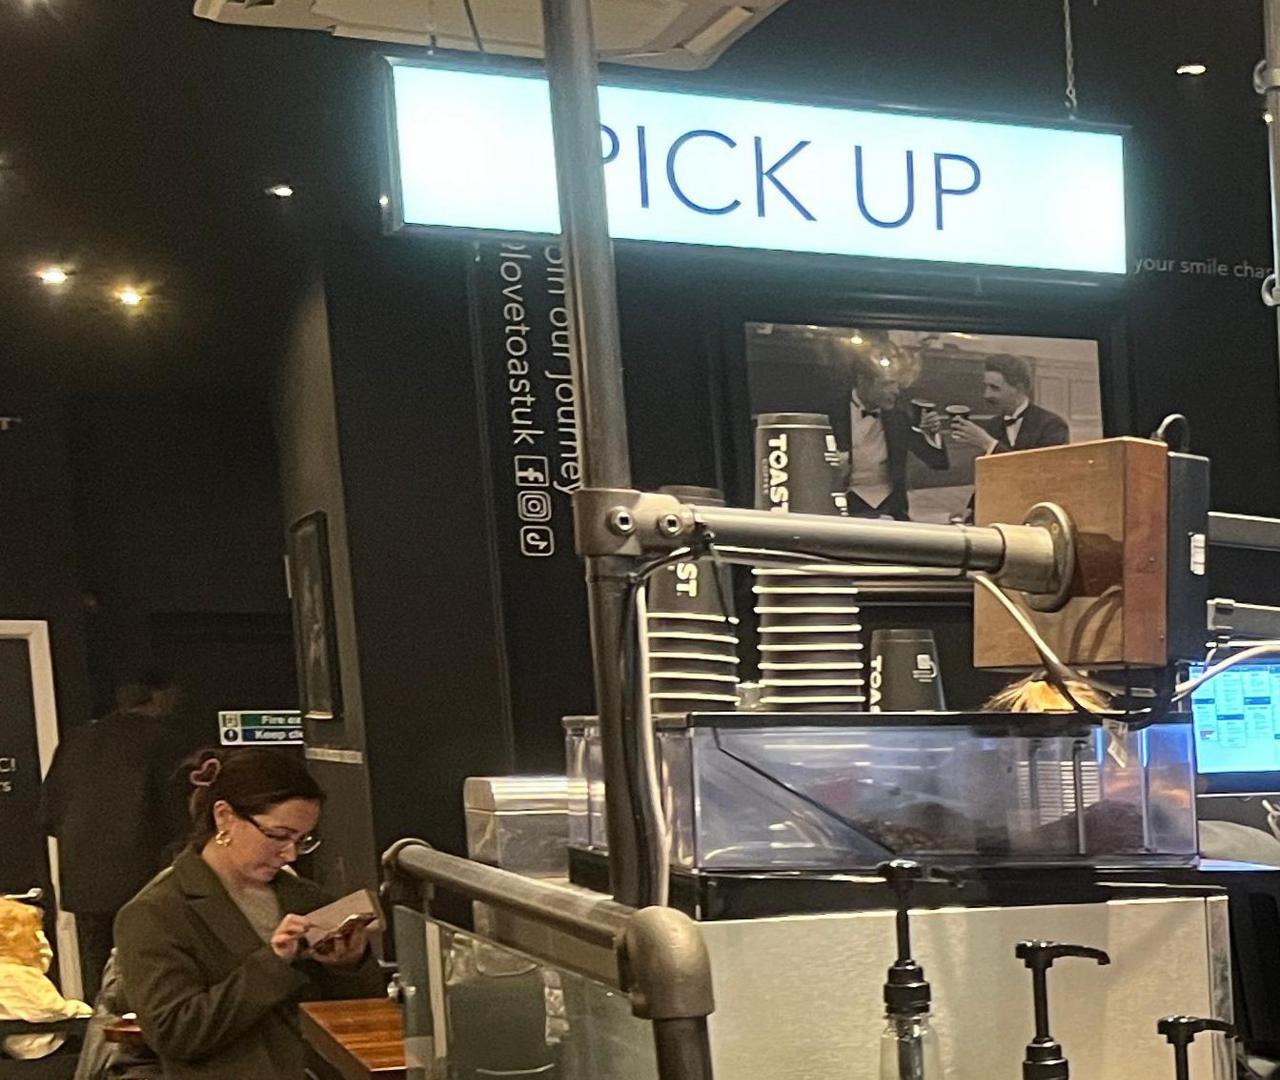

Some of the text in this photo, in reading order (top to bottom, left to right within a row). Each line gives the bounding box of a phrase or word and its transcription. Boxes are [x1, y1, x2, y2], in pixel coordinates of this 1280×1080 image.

[853, 144, 982, 232] UP
[1134, 254, 1229, 277] your smile
